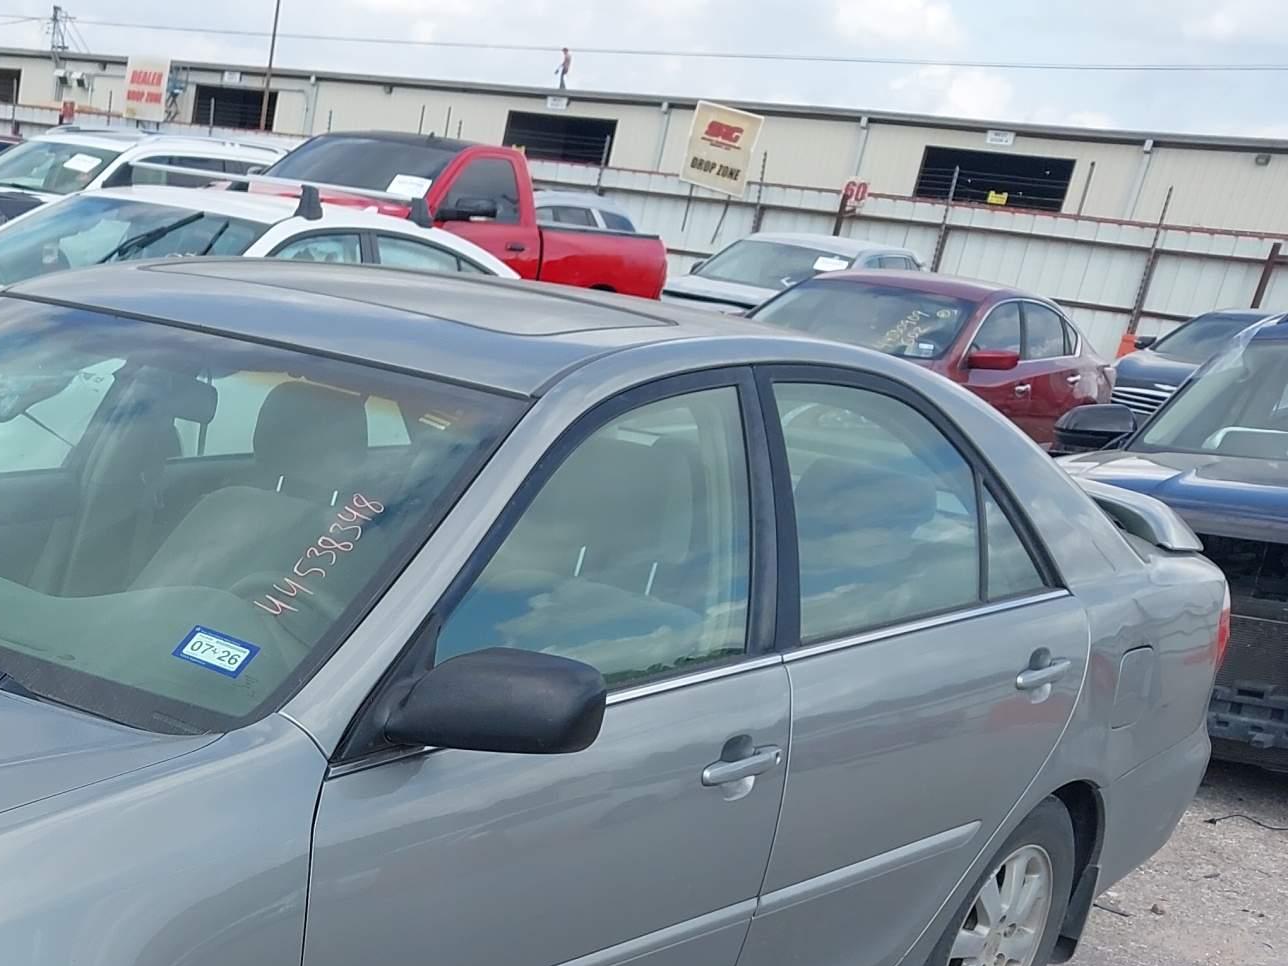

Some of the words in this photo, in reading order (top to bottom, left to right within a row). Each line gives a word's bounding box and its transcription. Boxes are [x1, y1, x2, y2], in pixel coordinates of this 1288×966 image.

[130, 70, 163, 86] DEALER
[690, 156, 717, 174] DROP
[716, 164, 741, 181] ZONE
[844, 181, 868, 201] 60
[253, 493, 384, 615] 44538348
